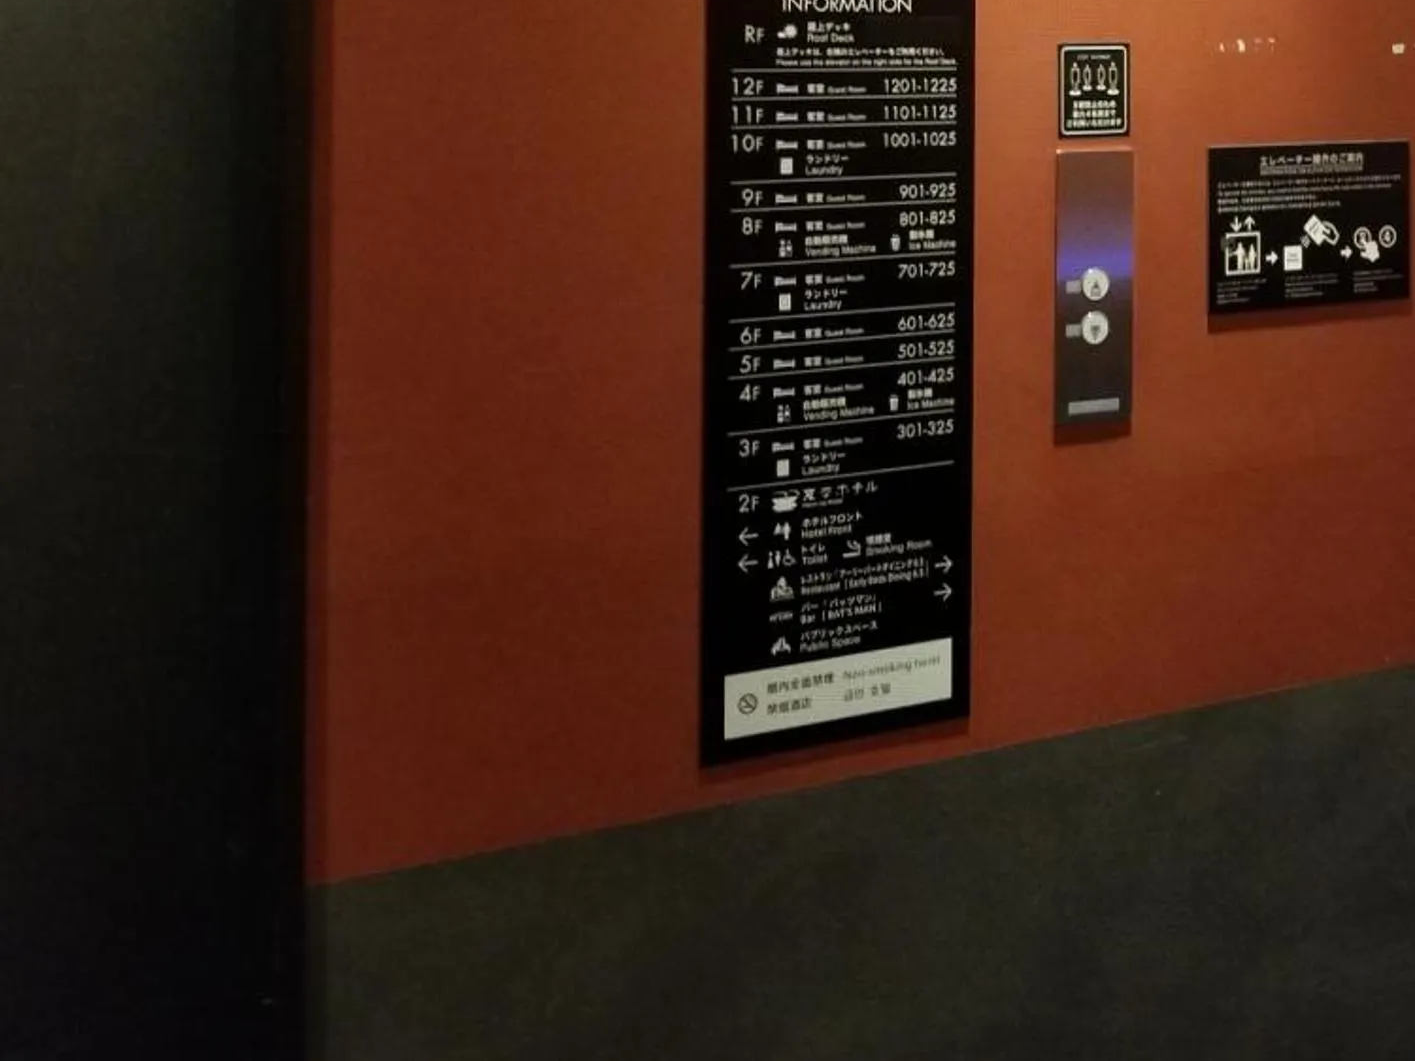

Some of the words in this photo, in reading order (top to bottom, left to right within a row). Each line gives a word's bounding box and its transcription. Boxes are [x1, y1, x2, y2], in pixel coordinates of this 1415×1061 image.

[744, 24, 765, 43] RF
[732, 77, 764, 96] 12F
[884, 77, 957, 93] 1201-1225
[732, 105, 764, 124] 11F
[883, 105, 957, 120] 1101-1125
[732, 134, 764, 153] 10F
[883, 132, 957, 148] 1001-1025
[805, 165, 843, 177] Laundry
[741, 188, 763, 206] 9F
[899, 183, 956, 200] 901-925
[741, 216, 763, 235] 8F
[899, 209, 956, 226] 801-825
[898, 261, 956, 279] 701-725
[740, 271, 762, 290] 7F
[898, 313, 956, 331] 601-625
[740, 327, 762, 345] 6F
[897, 340, 955, 358] 501-525
[739, 355, 761, 373] 5F
[897, 367, 955, 386] 401-425
[739, 384, 760, 401] 4F
[897, 419, 954, 439] 301-325
[739, 439, 760, 457] 3F
[738, 494, 760, 513] 2F
